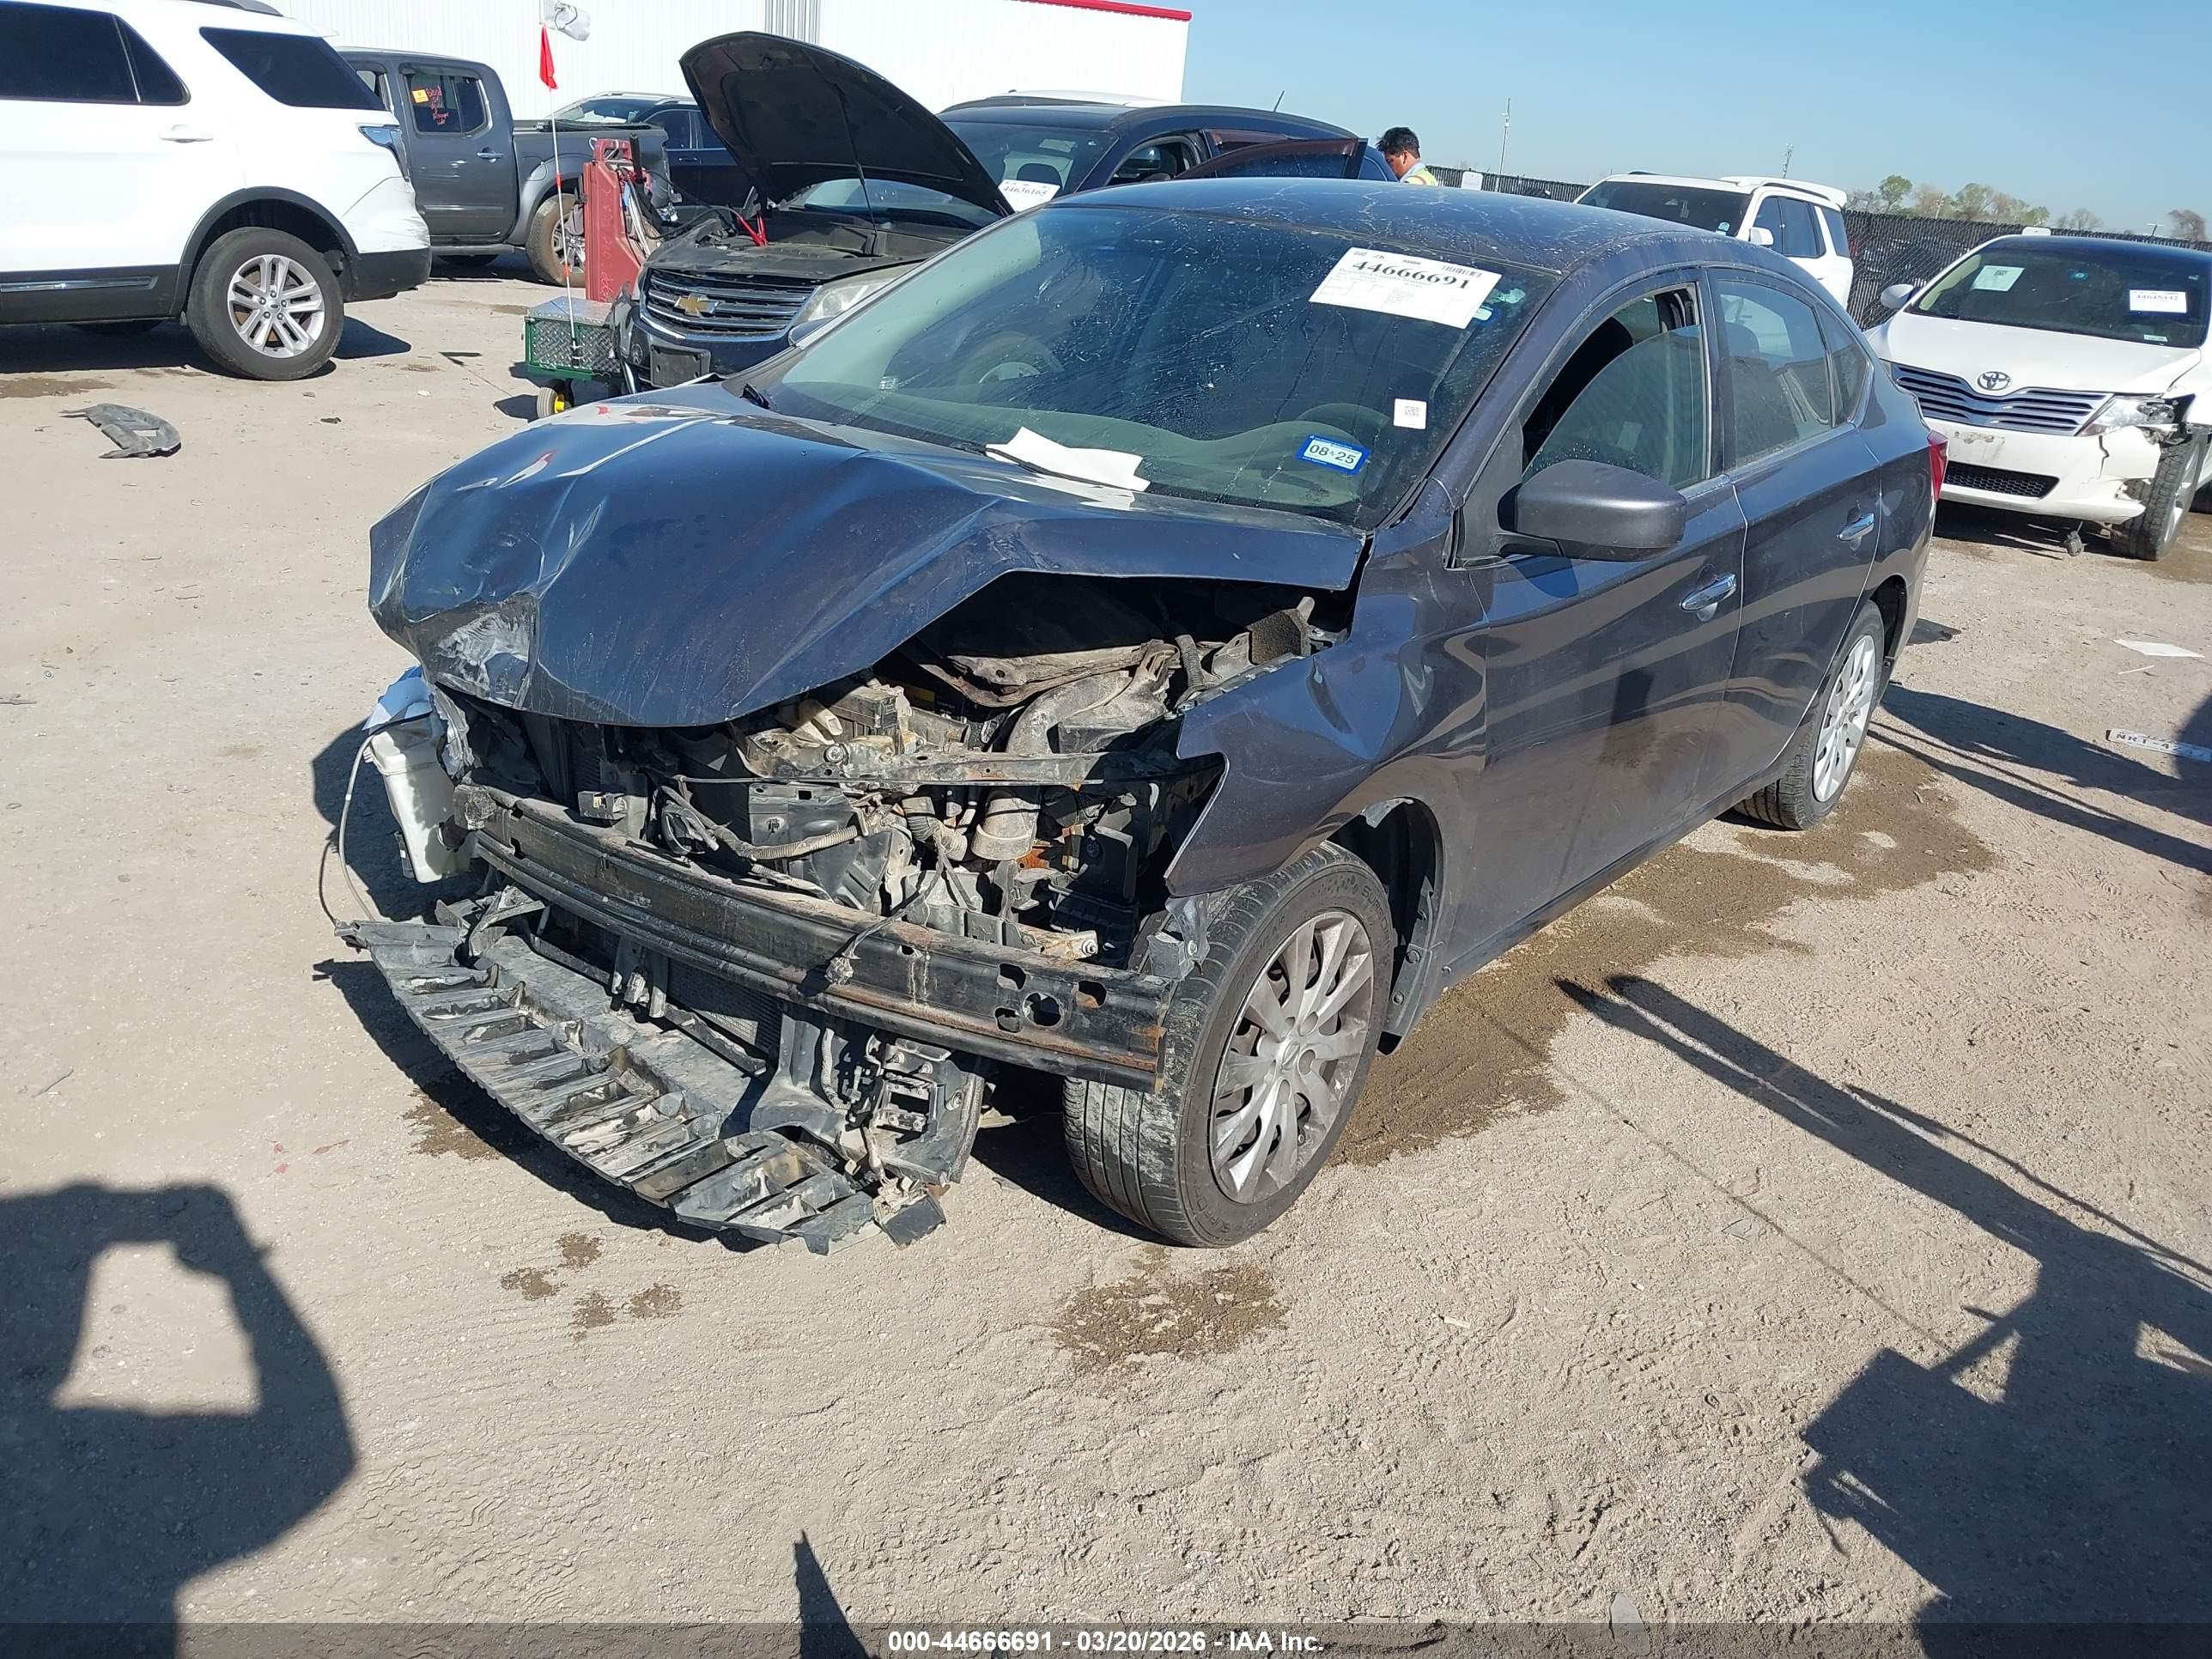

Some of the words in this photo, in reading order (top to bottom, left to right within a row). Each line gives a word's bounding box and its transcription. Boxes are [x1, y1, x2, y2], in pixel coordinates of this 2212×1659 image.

[1352, 261, 1470, 289] 44666691
[1310, 444, 1330, 456] 08
[1334, 452, 1357, 465] 25
